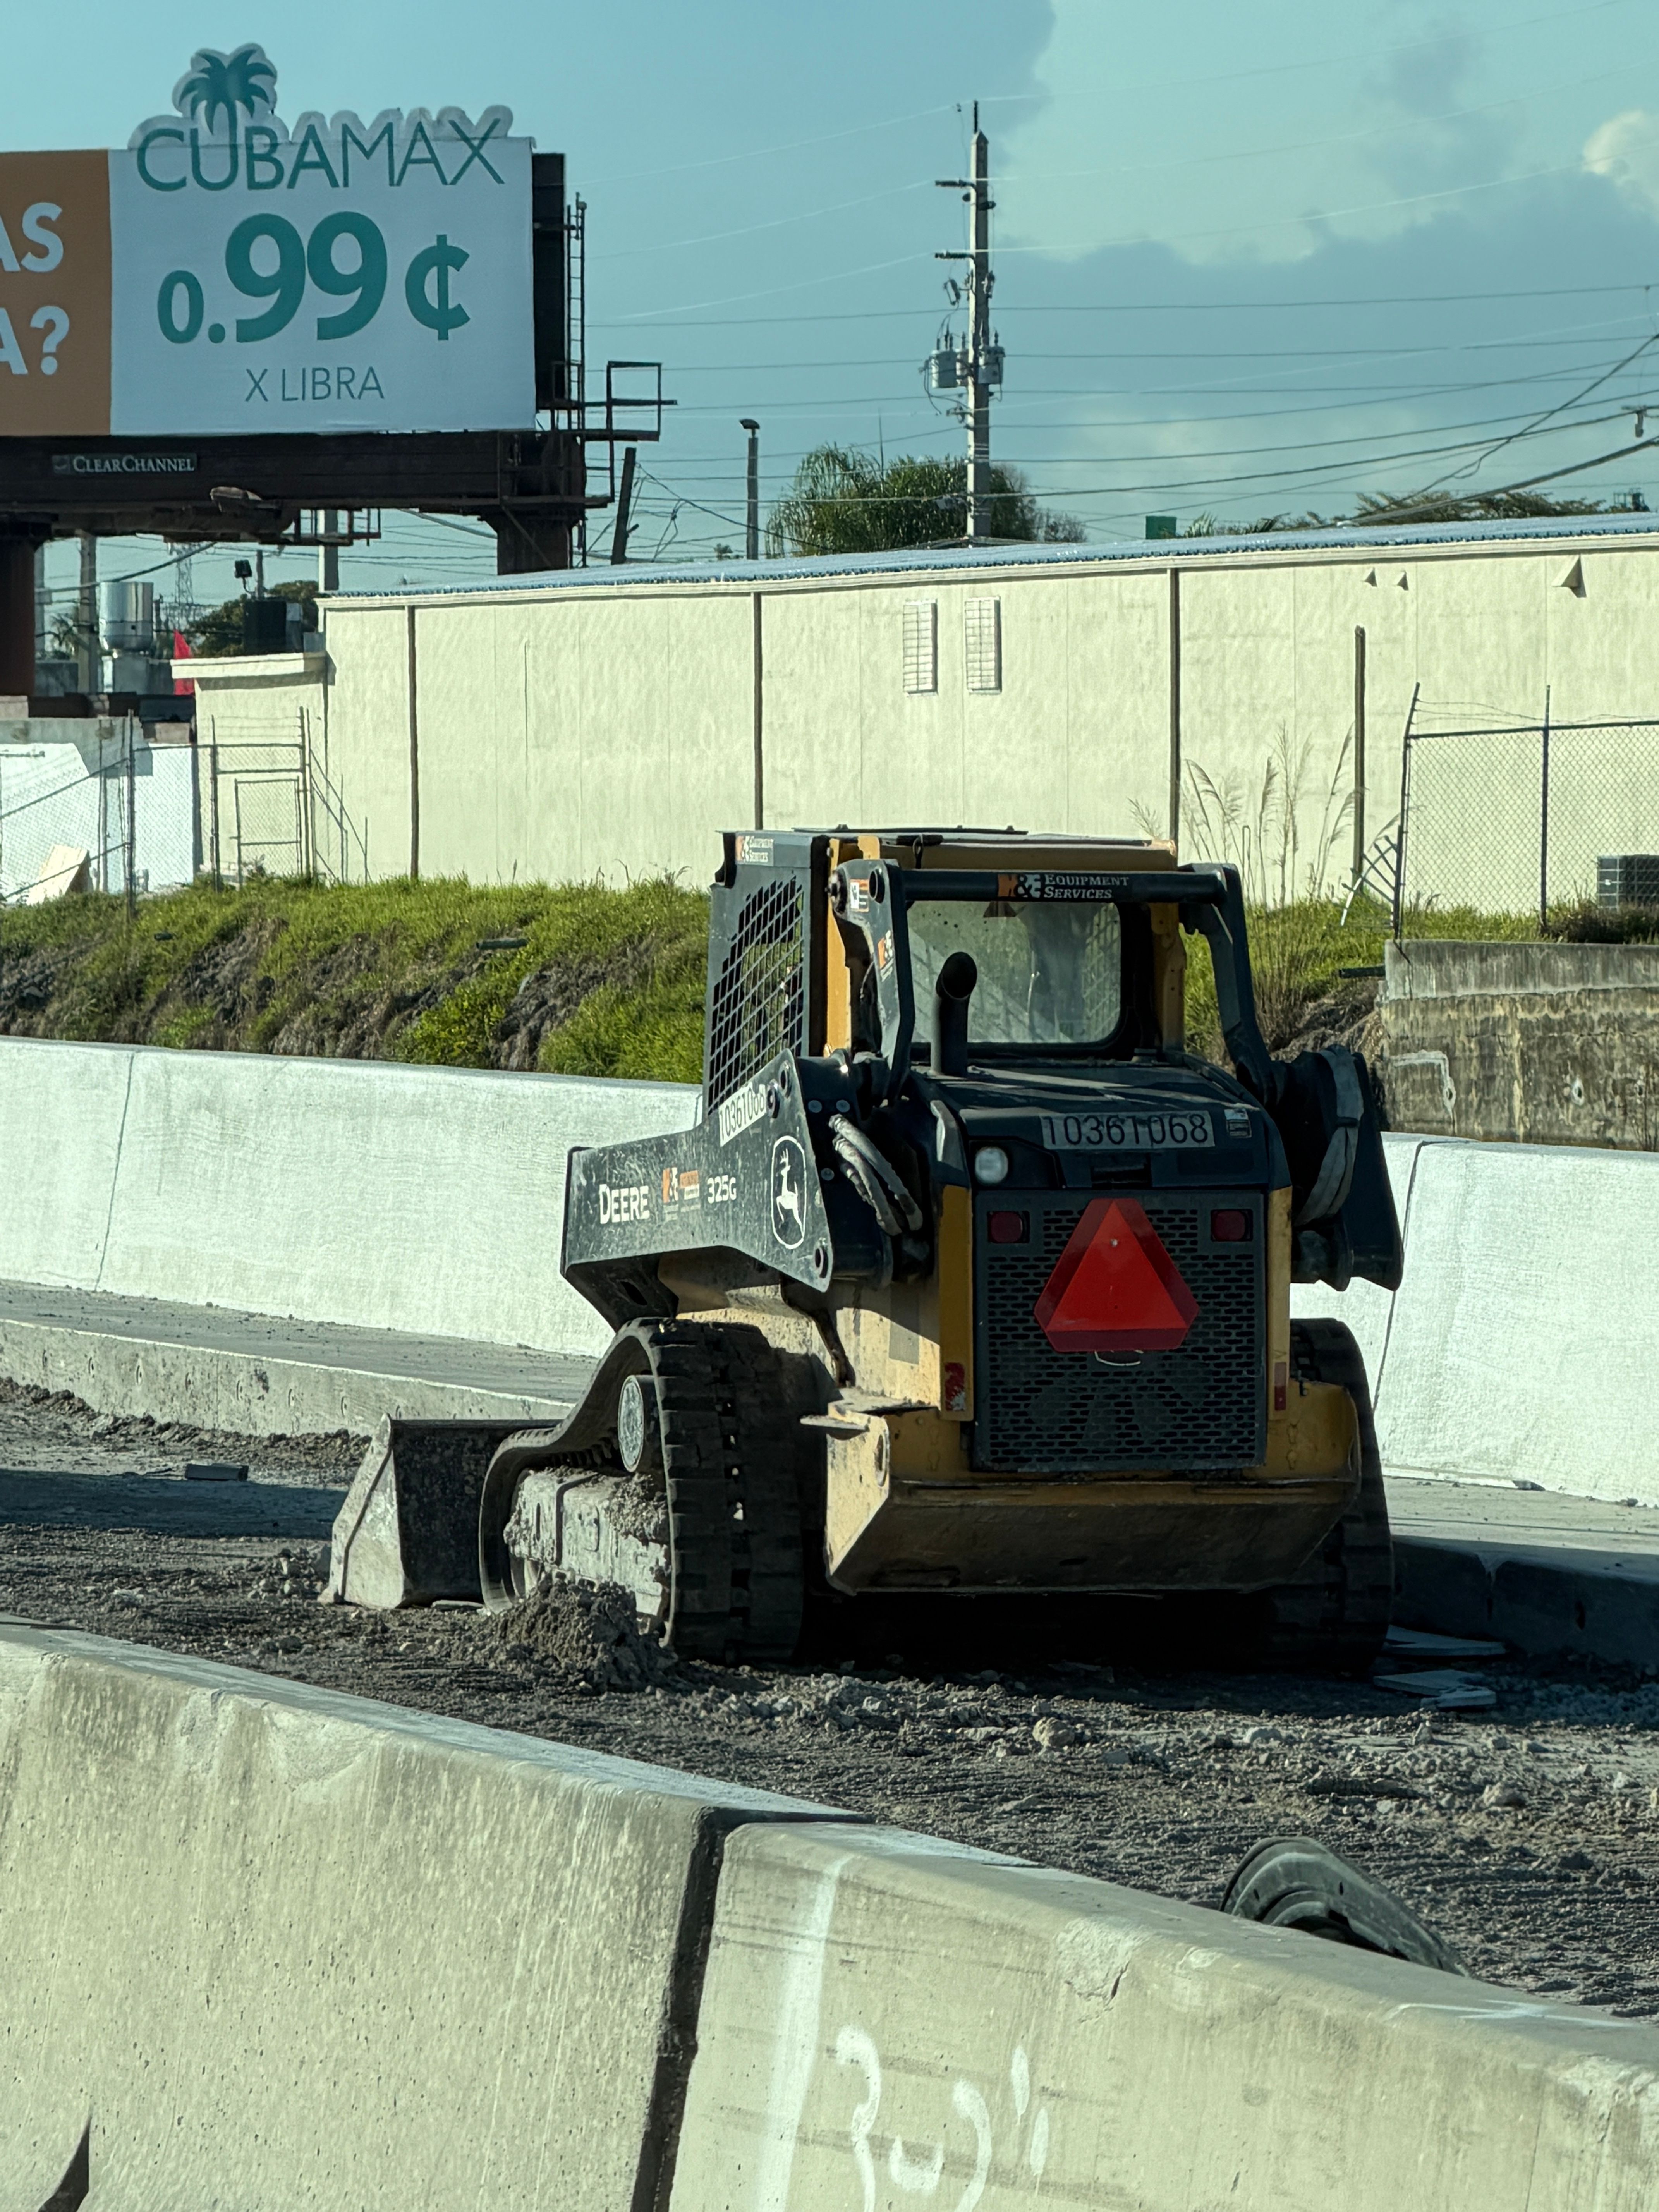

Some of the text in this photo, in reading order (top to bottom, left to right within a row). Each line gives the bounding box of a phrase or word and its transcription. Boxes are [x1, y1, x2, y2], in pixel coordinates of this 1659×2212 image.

[136, 118, 505, 191] CUBAMAX
[245, 366, 385, 402] X LIBRA
[1044, 874, 1129, 886] EQUIPMENT
[1044, 886, 1113, 899] SERVICES
[1042, 1114, 1209, 1145] 10361068
[599, 1183, 650, 1224] DEERE
[707, 1175, 737, 1204] 325G
